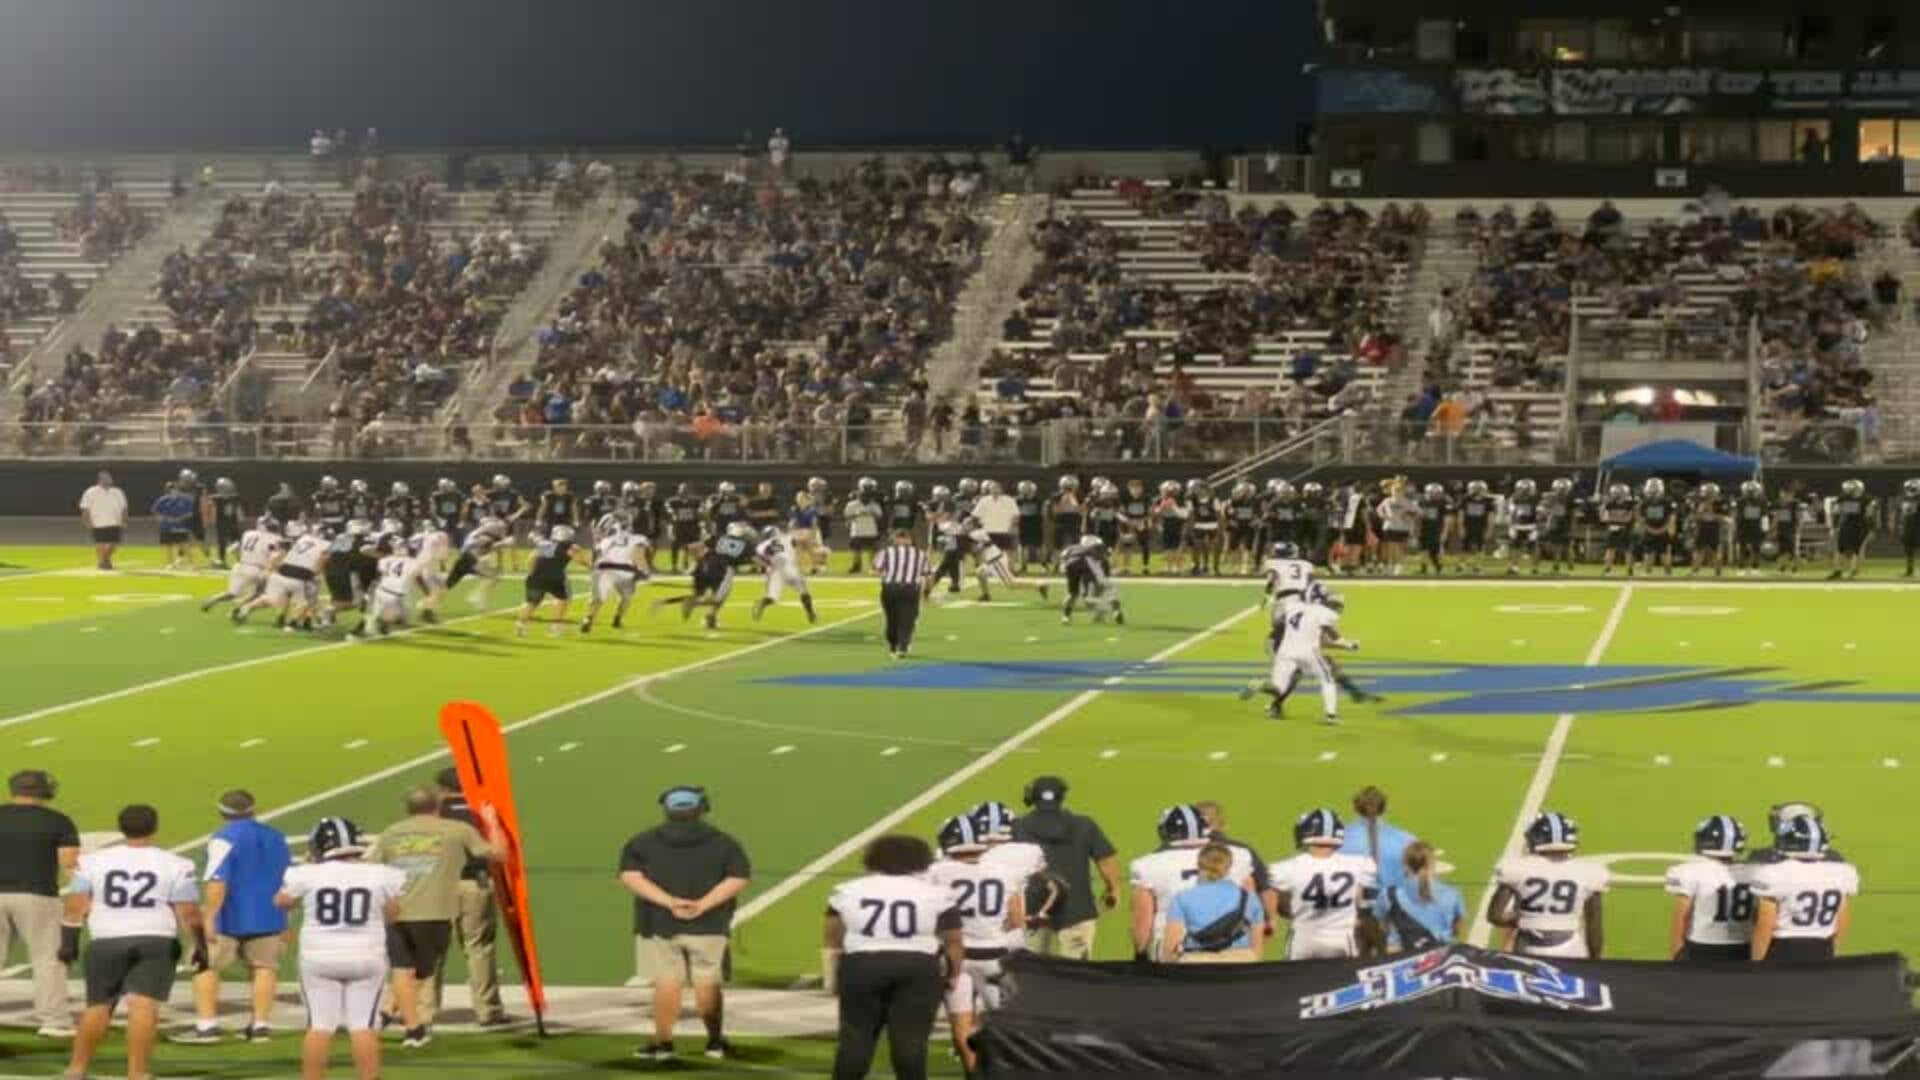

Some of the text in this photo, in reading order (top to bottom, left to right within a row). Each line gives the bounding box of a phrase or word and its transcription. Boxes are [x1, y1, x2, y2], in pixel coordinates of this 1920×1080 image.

[1289, 563, 1301, 580] 3
[1289, 611, 1304, 630] 4
[103, 869, 157, 908] 62
[315, 887, 371, 926] 80
[951, 878, 1004, 917] 20
[1301, 871, 1355, 909] 42
[1520, 877, 1579, 915] 29
[1712, 883, 1752, 923] 18
[860, 898, 917, 939] 70
[1791, 889, 1843, 927] 38
